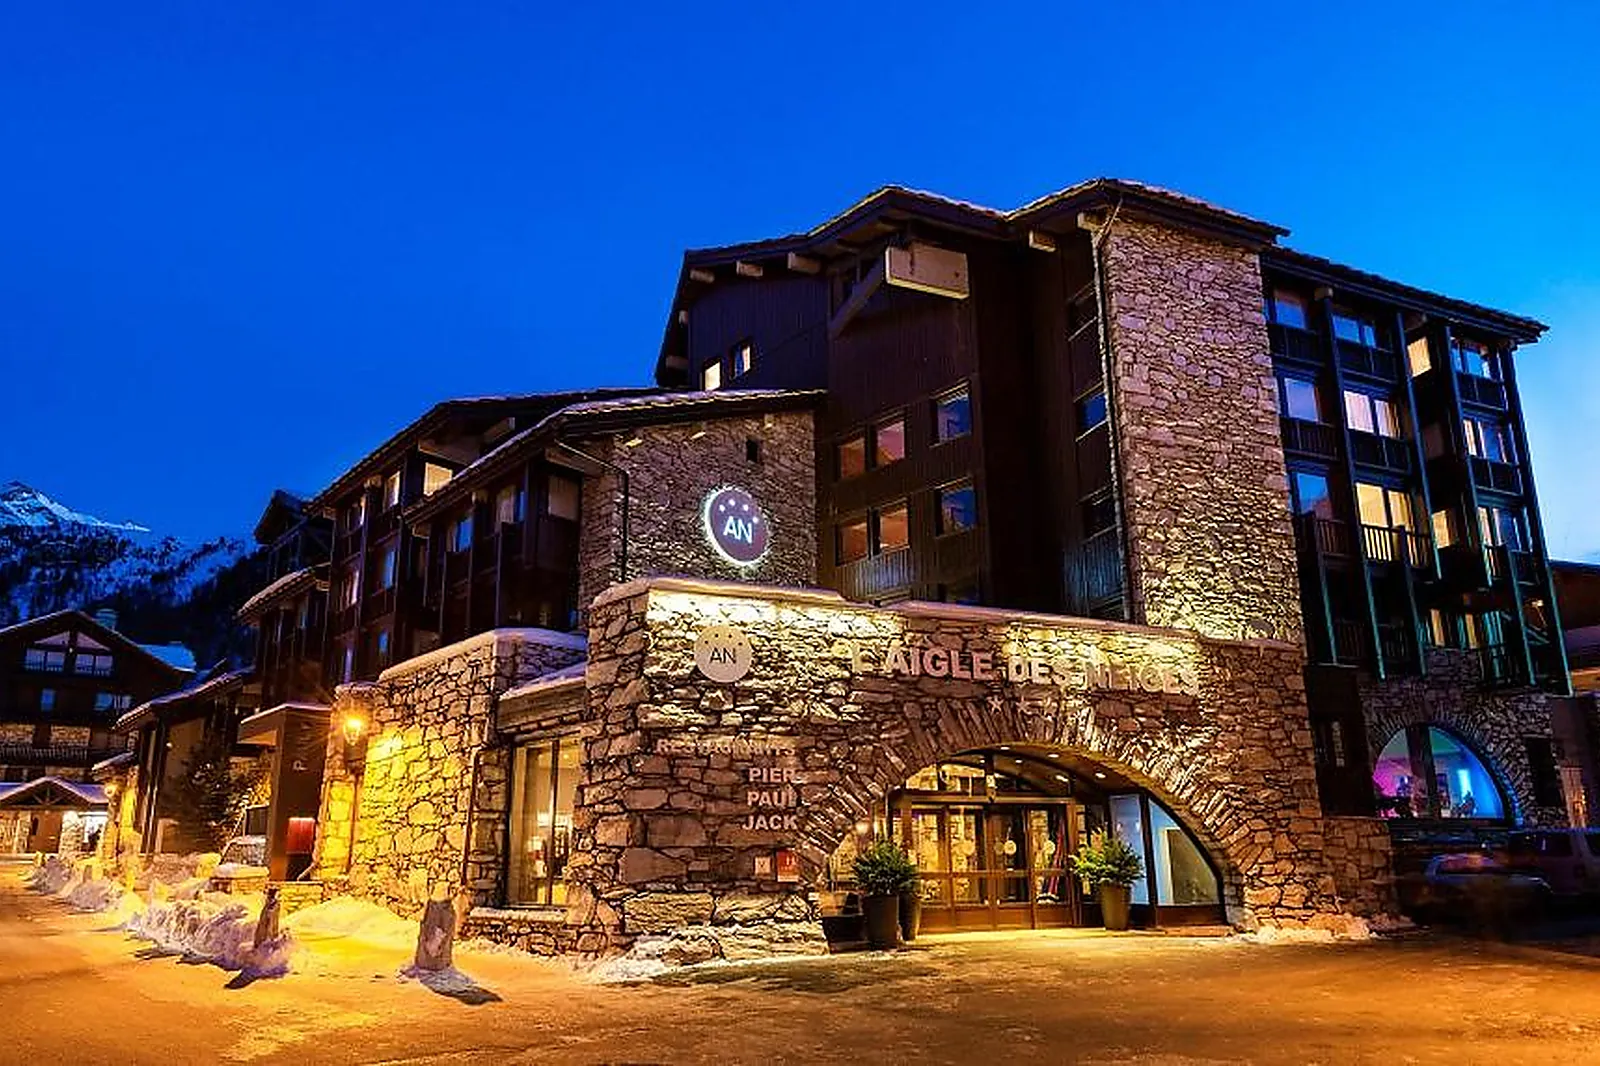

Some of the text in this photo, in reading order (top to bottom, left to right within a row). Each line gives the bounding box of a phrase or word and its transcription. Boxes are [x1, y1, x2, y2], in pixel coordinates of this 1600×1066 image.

[723, 515, 753, 544] AN
[708, 647, 737, 665] AN
[748, 767, 797, 783] PIER
[747, 791, 797, 808] PAUL
[741, 814, 798, 831] JACK
